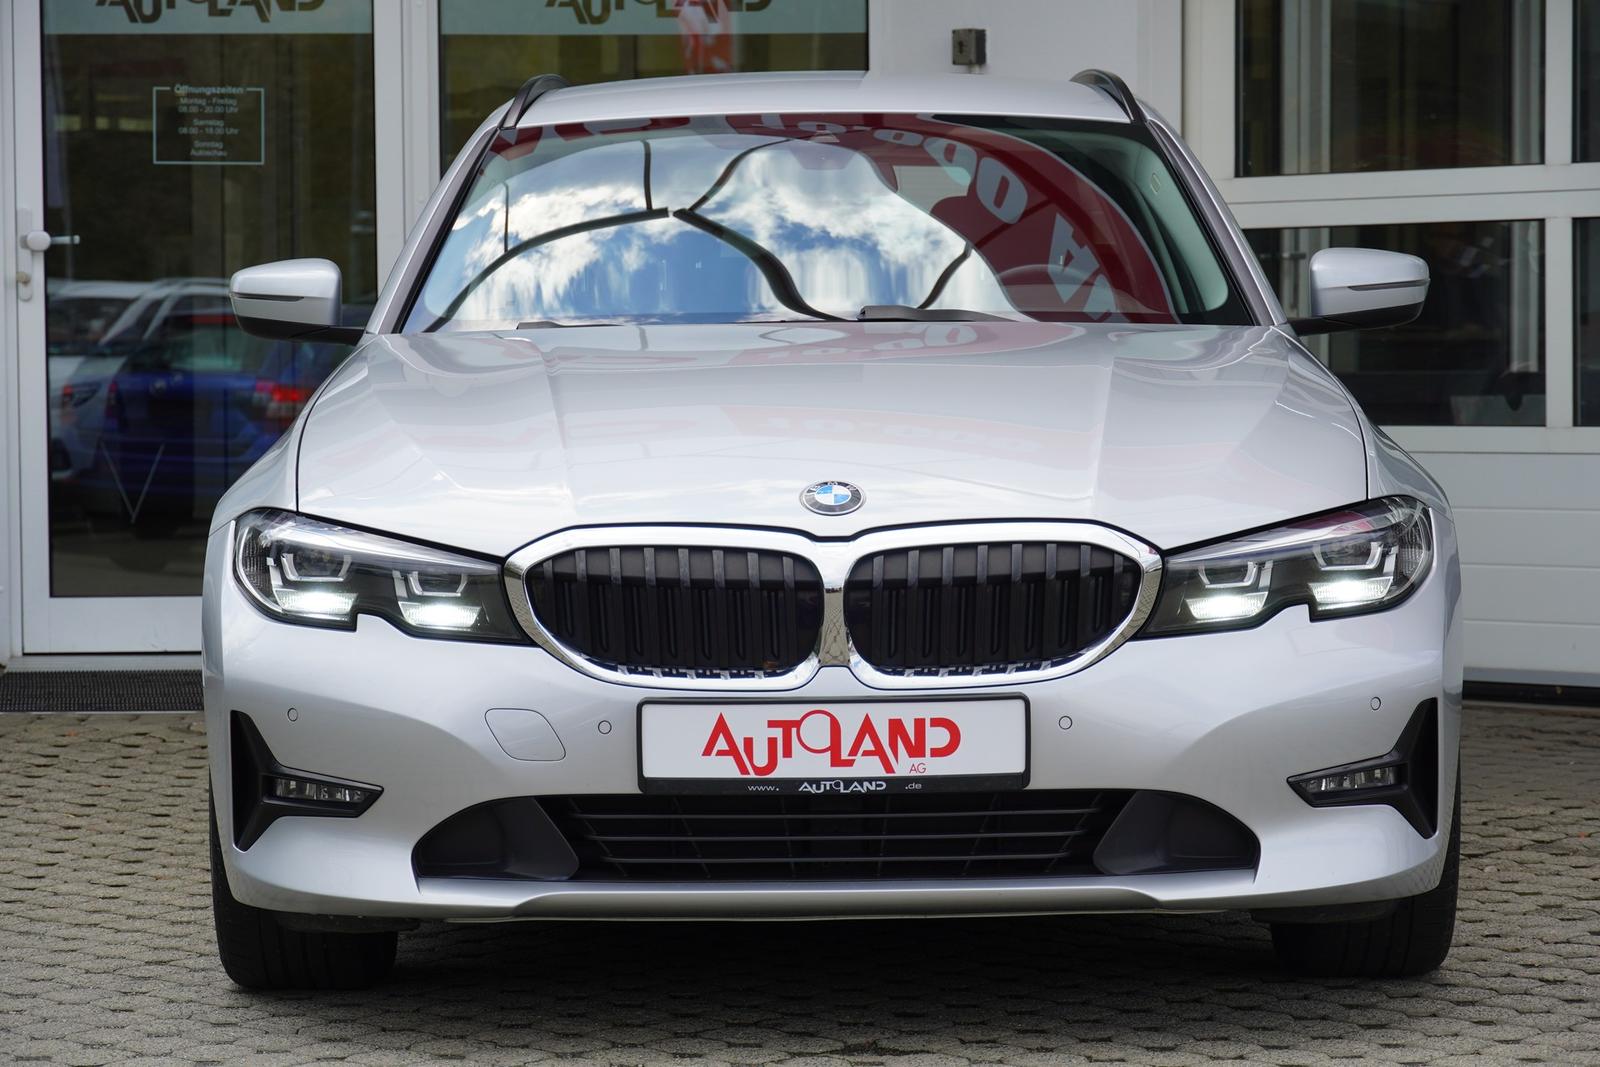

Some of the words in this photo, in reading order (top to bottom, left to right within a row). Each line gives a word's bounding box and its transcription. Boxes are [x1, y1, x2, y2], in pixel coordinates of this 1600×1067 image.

[909, 763, 927, 775] AG
[747, 784, 780, 792] www.
[905, 782, 923, 791] .de
